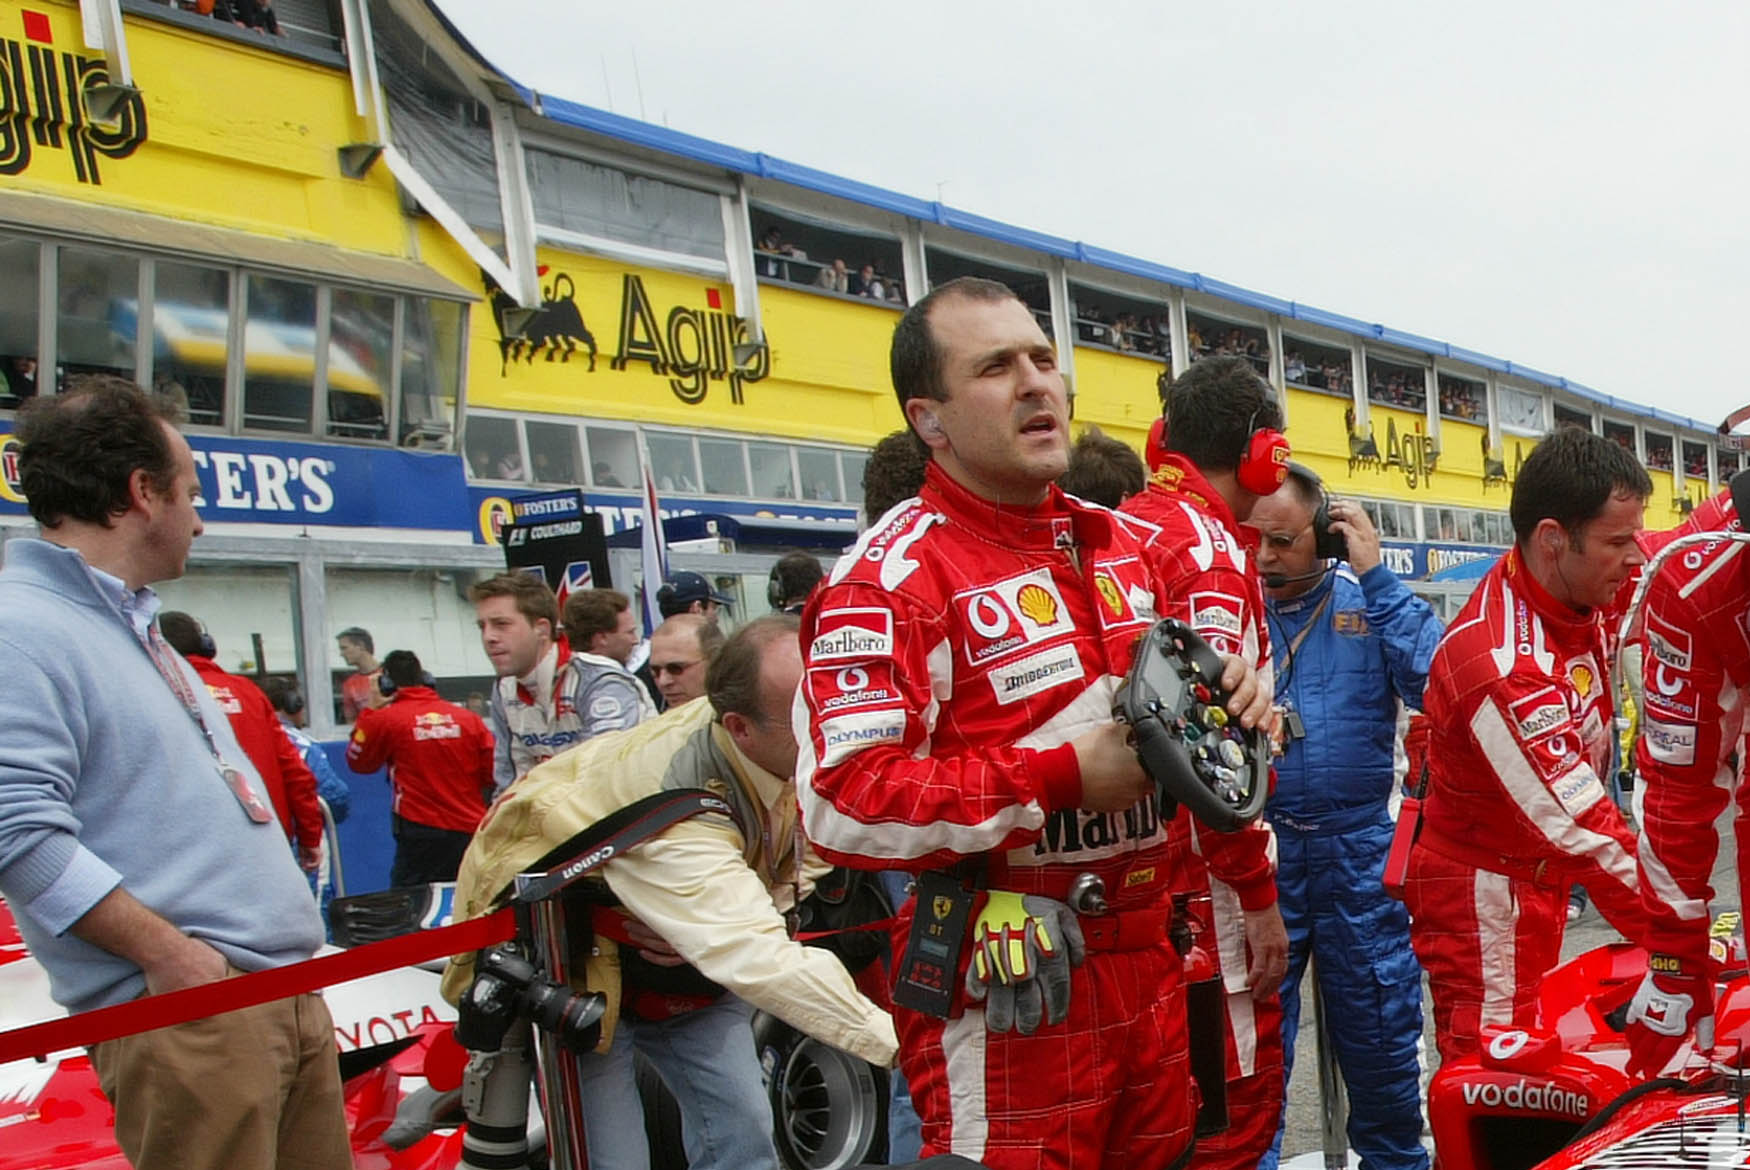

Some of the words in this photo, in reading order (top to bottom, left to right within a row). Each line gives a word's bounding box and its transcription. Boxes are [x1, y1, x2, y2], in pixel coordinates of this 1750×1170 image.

[612, 275, 770, 404] Agip
[1383, 416, 1438, 490] Agip
[813, 631, 885, 656] Marlboro
[976, 635, 1024, 658] vodafone
[823, 689, 888, 707] vodafone
[827, 727, 902, 747] OLYMPUS
[562, 846, 615, 880] Canon
[1463, 1078, 1589, 1118] vodafone
